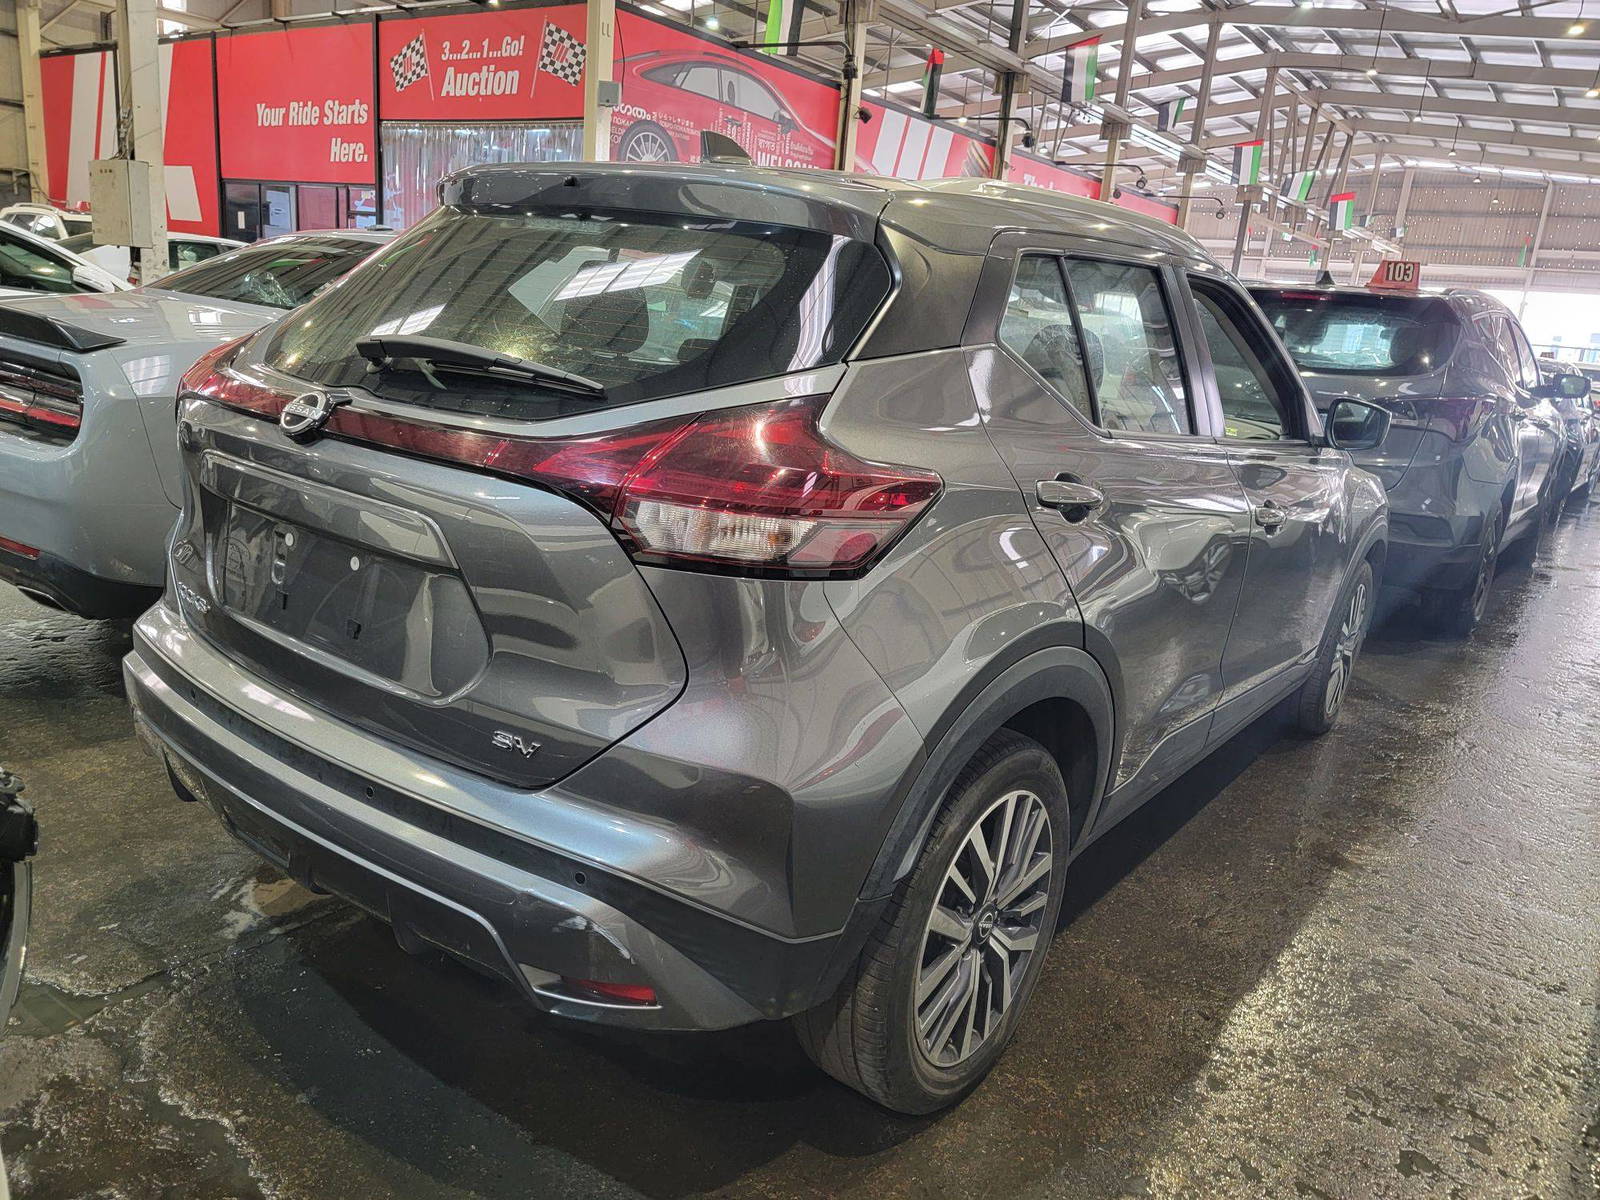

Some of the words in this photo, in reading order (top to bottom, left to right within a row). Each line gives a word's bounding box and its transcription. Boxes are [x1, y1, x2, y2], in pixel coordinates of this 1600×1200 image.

[441, 35, 525, 61] 3...2...1...Go!
[440, 64, 520, 97] Auction
[256, 103, 286, 127] Your
[288, 101, 320, 126] Ride
[323, 99, 369, 125] Starts
[330, 137, 369, 163] Here.
[1388, 262, 1414, 282] 103
[491, 730, 541, 758] SV
